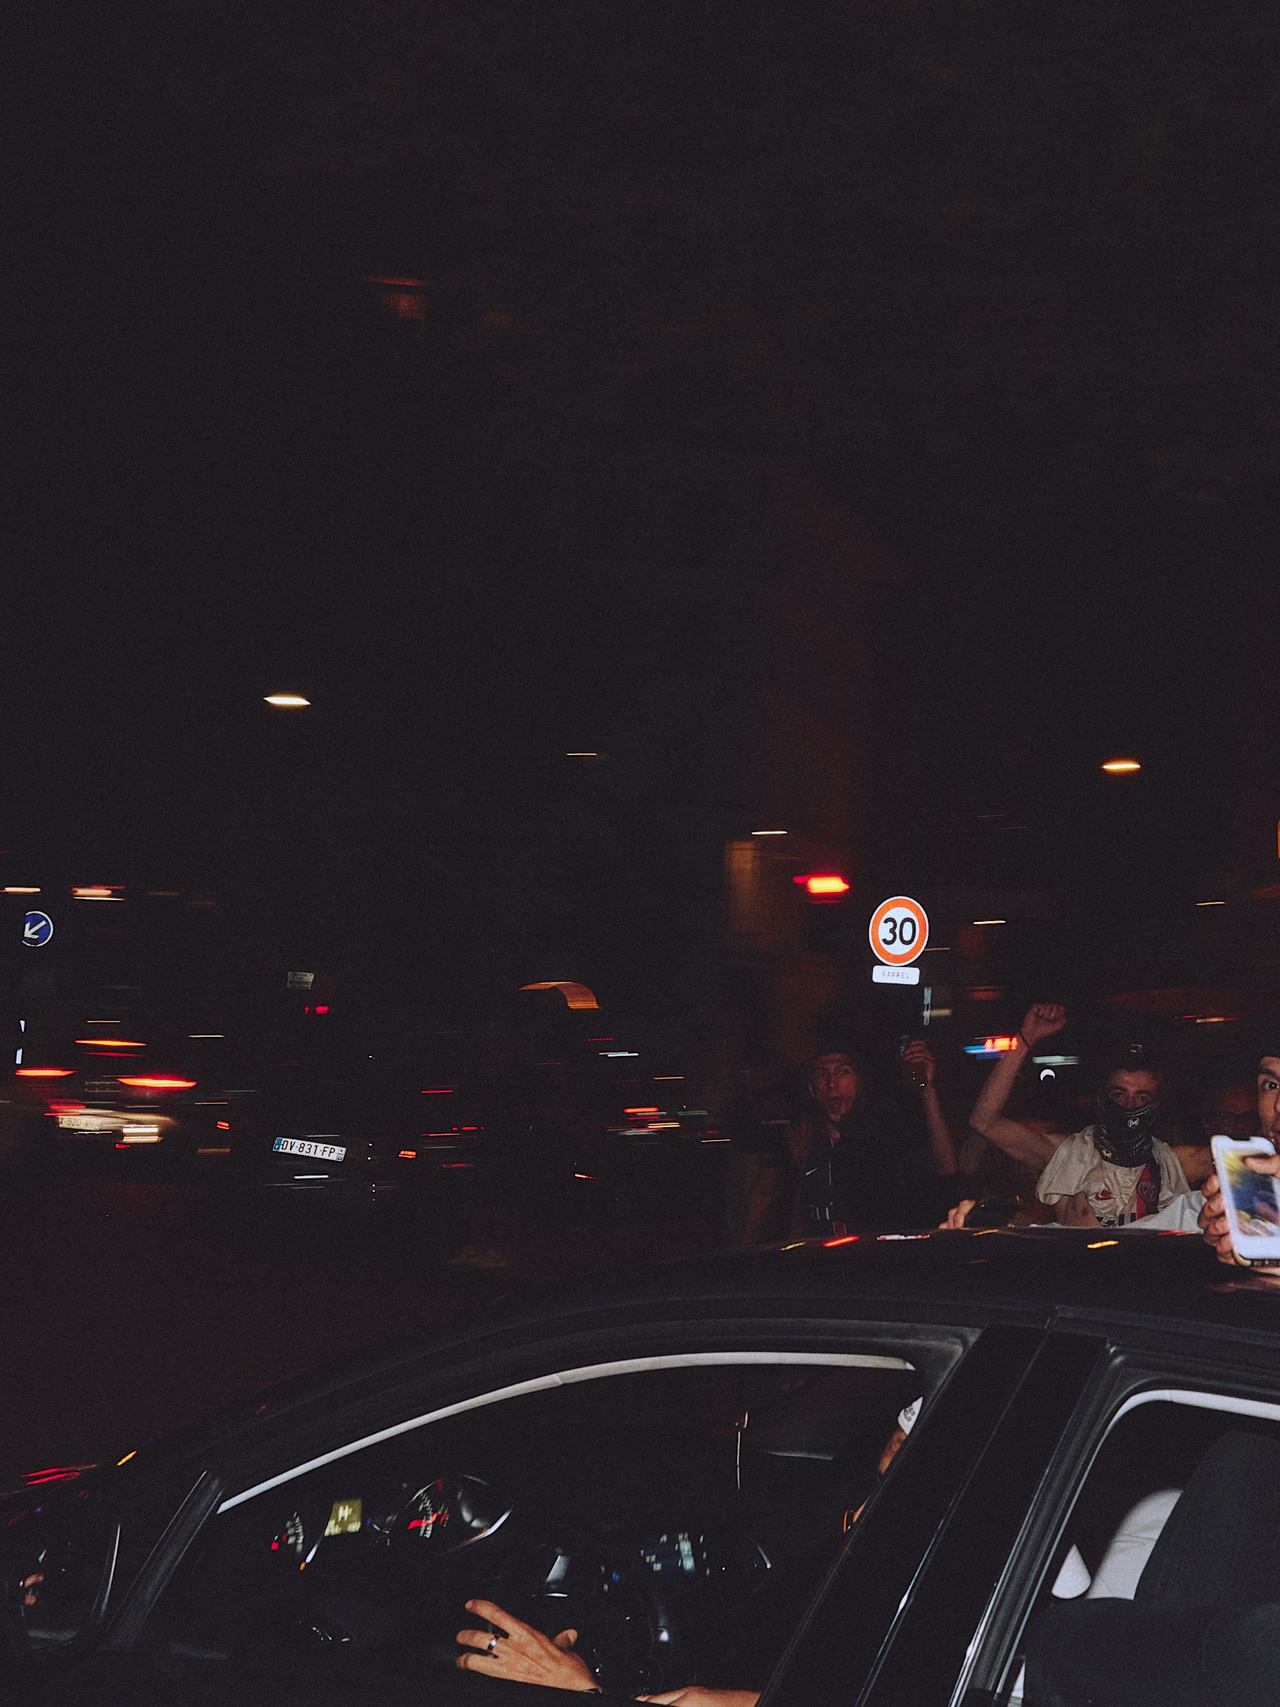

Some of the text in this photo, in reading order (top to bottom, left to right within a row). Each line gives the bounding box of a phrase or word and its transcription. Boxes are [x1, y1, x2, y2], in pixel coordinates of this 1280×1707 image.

[882, 917, 916, 945] 30
[882, 971, 909, 979] RAPPEL
[281, 1139, 336, 1158] DV-831-FP
